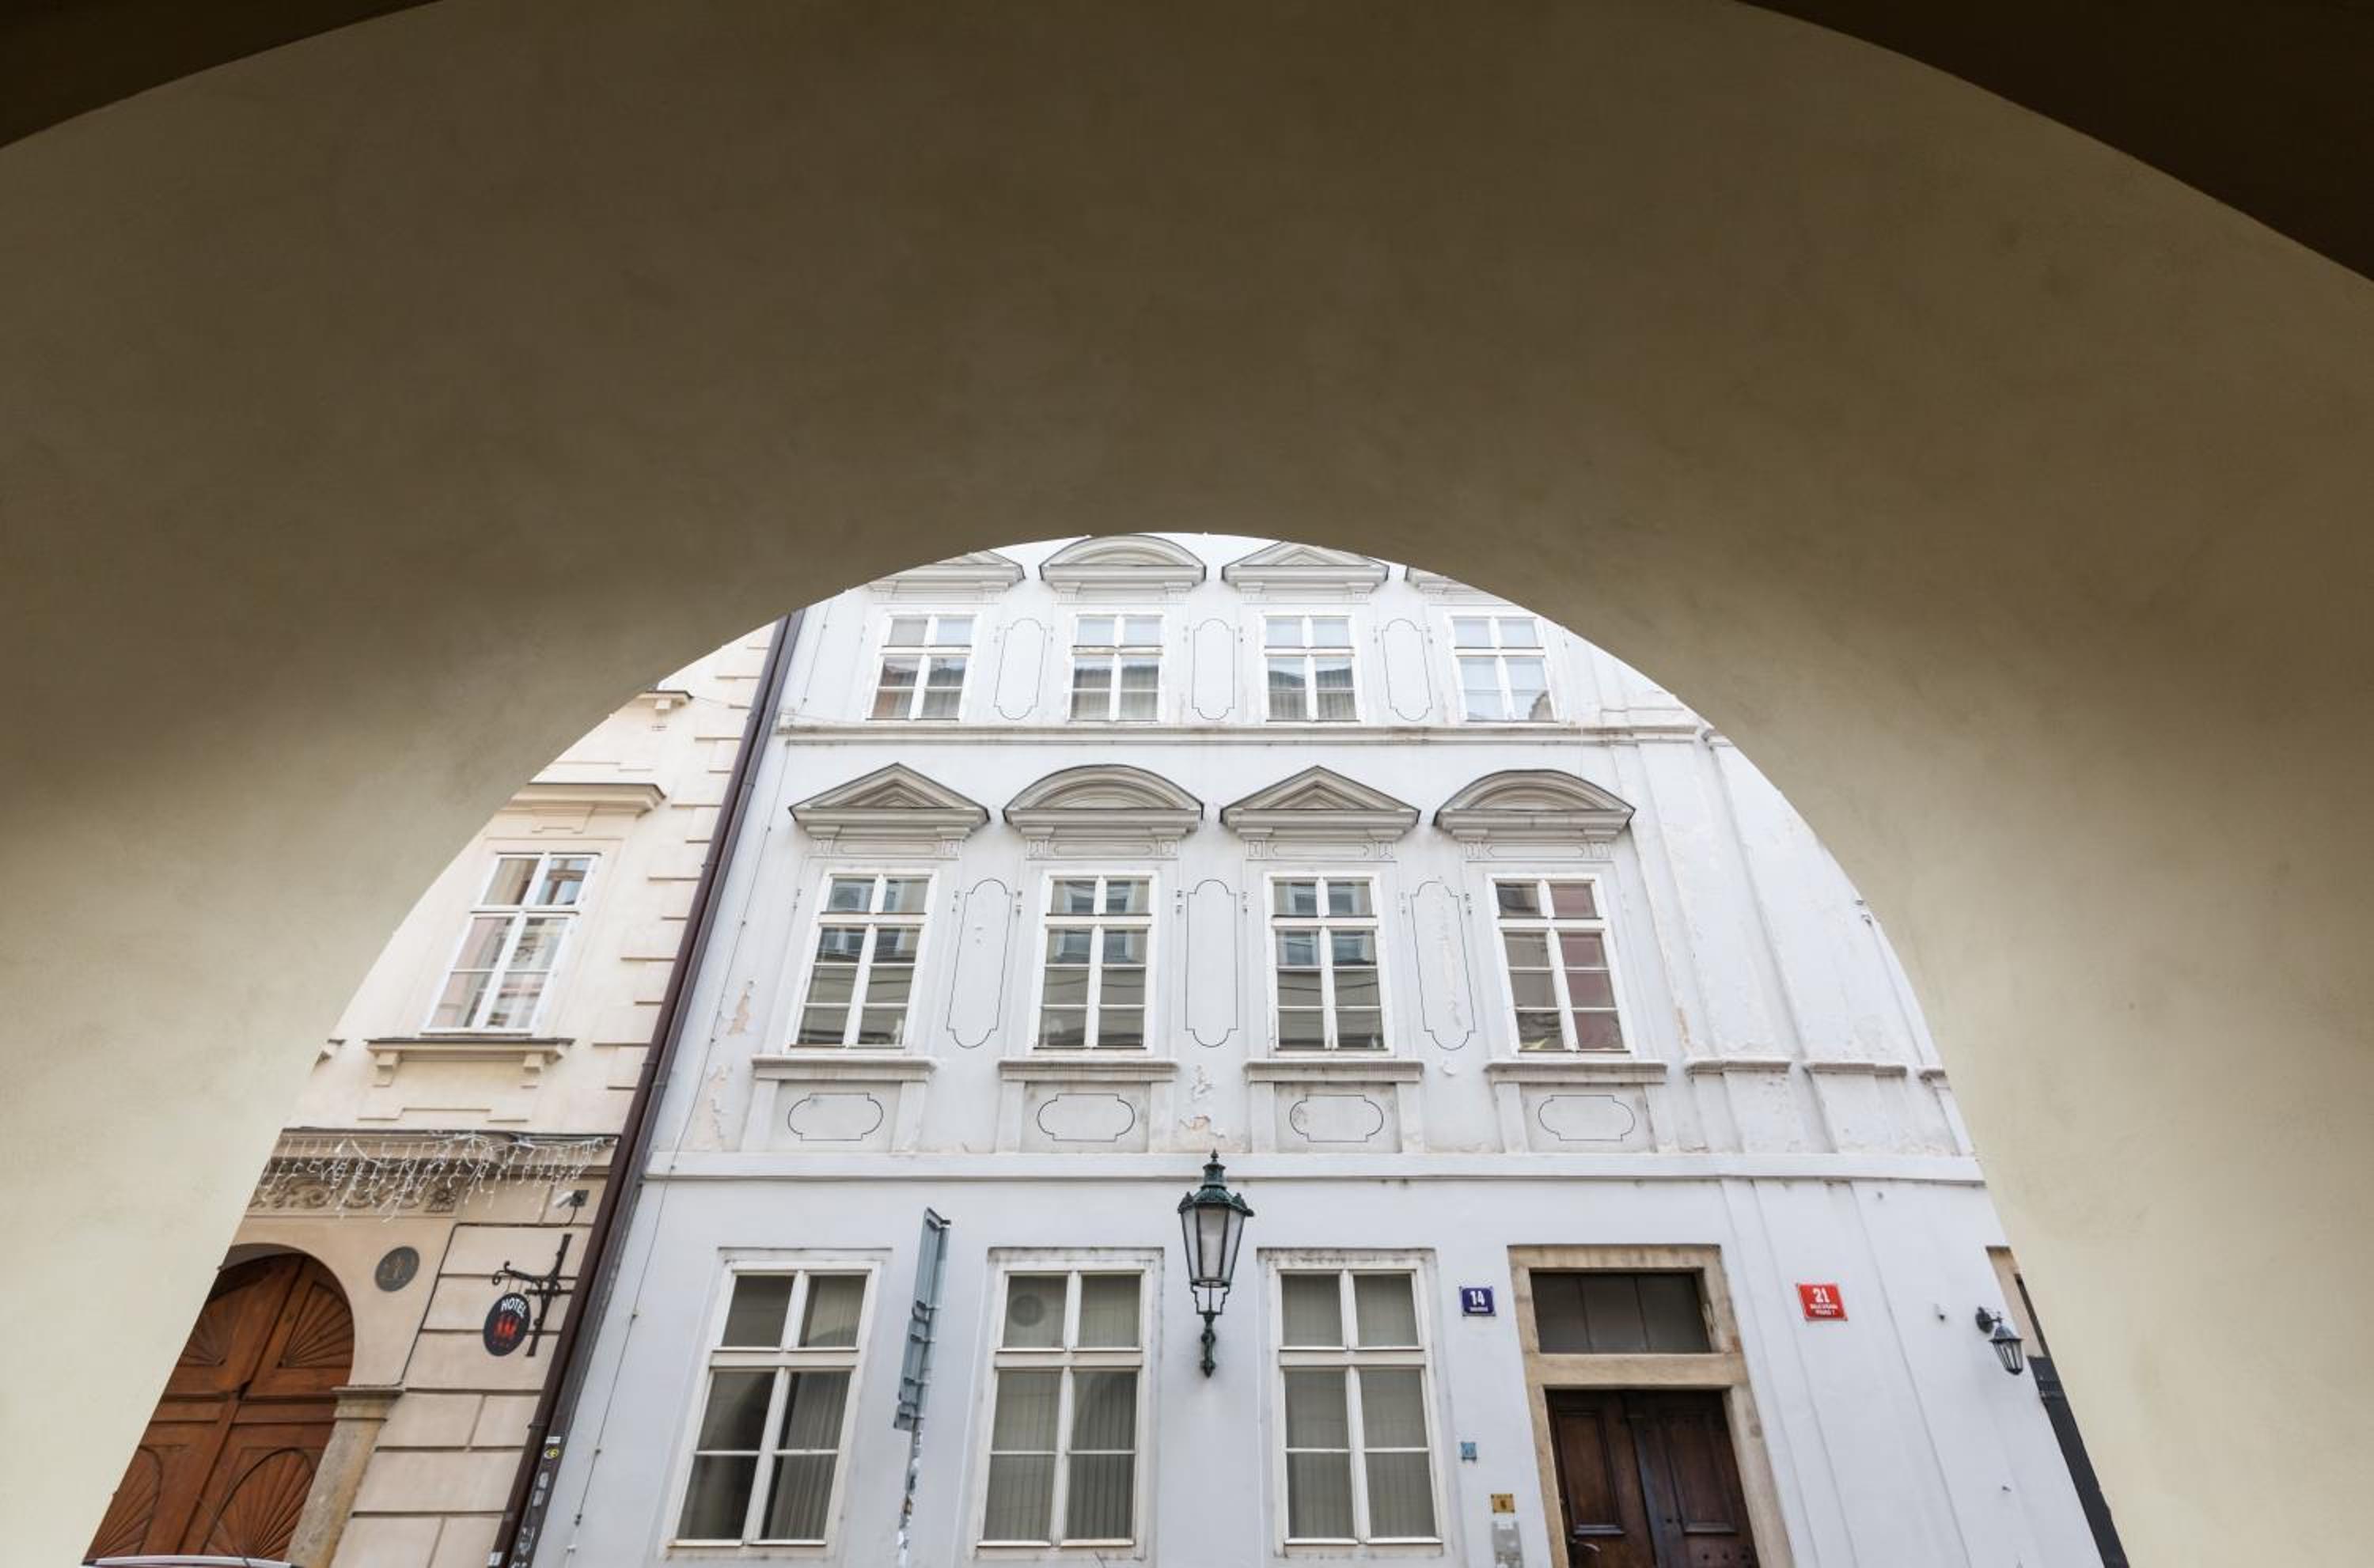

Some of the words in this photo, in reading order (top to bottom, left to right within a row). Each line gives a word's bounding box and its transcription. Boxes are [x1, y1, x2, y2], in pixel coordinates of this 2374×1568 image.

[1470, 1290, 1485, 1305] 14
[1813, 1287, 1830, 1302] 21
[500, 1297, 527, 1318] HOTEL
